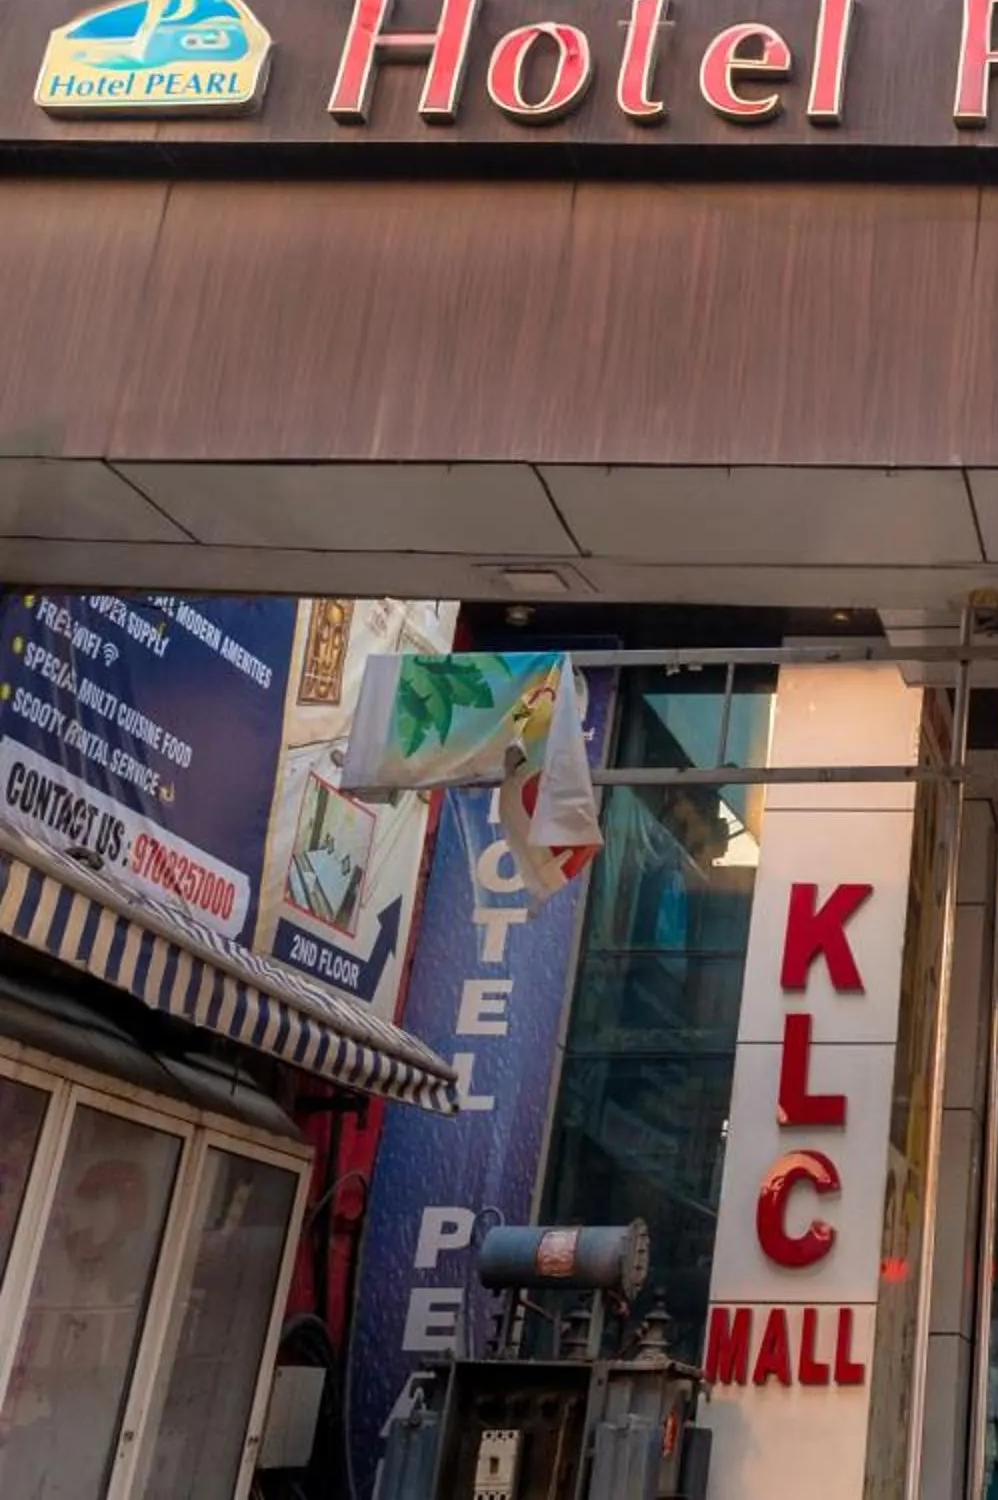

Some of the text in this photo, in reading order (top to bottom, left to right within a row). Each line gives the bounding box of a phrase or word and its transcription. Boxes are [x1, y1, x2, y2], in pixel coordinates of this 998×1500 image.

[49, 71, 242, 97] Hotel PEARL
[81, 596, 170, 658] OWER SUPPLY
[175, 602, 222, 651] MODERN
[219, 635, 273, 689] AMENITIES
[12, 687, 66, 737] SCOOTY
[109, 749, 160, 796] SERVICE
[24, 642, 194, 768] SPECIAL MULTI CUISINE FOOD
[6, 761, 99, 846] CONTACT
[96, 812, 126, 862] US
[288, 934, 361, 989] 2ND FLOOR
[453, 786, 529, 1112] OTEL
[755, 882, 875, 1270] KLC
[704, 1306, 867, 1387] MALL
